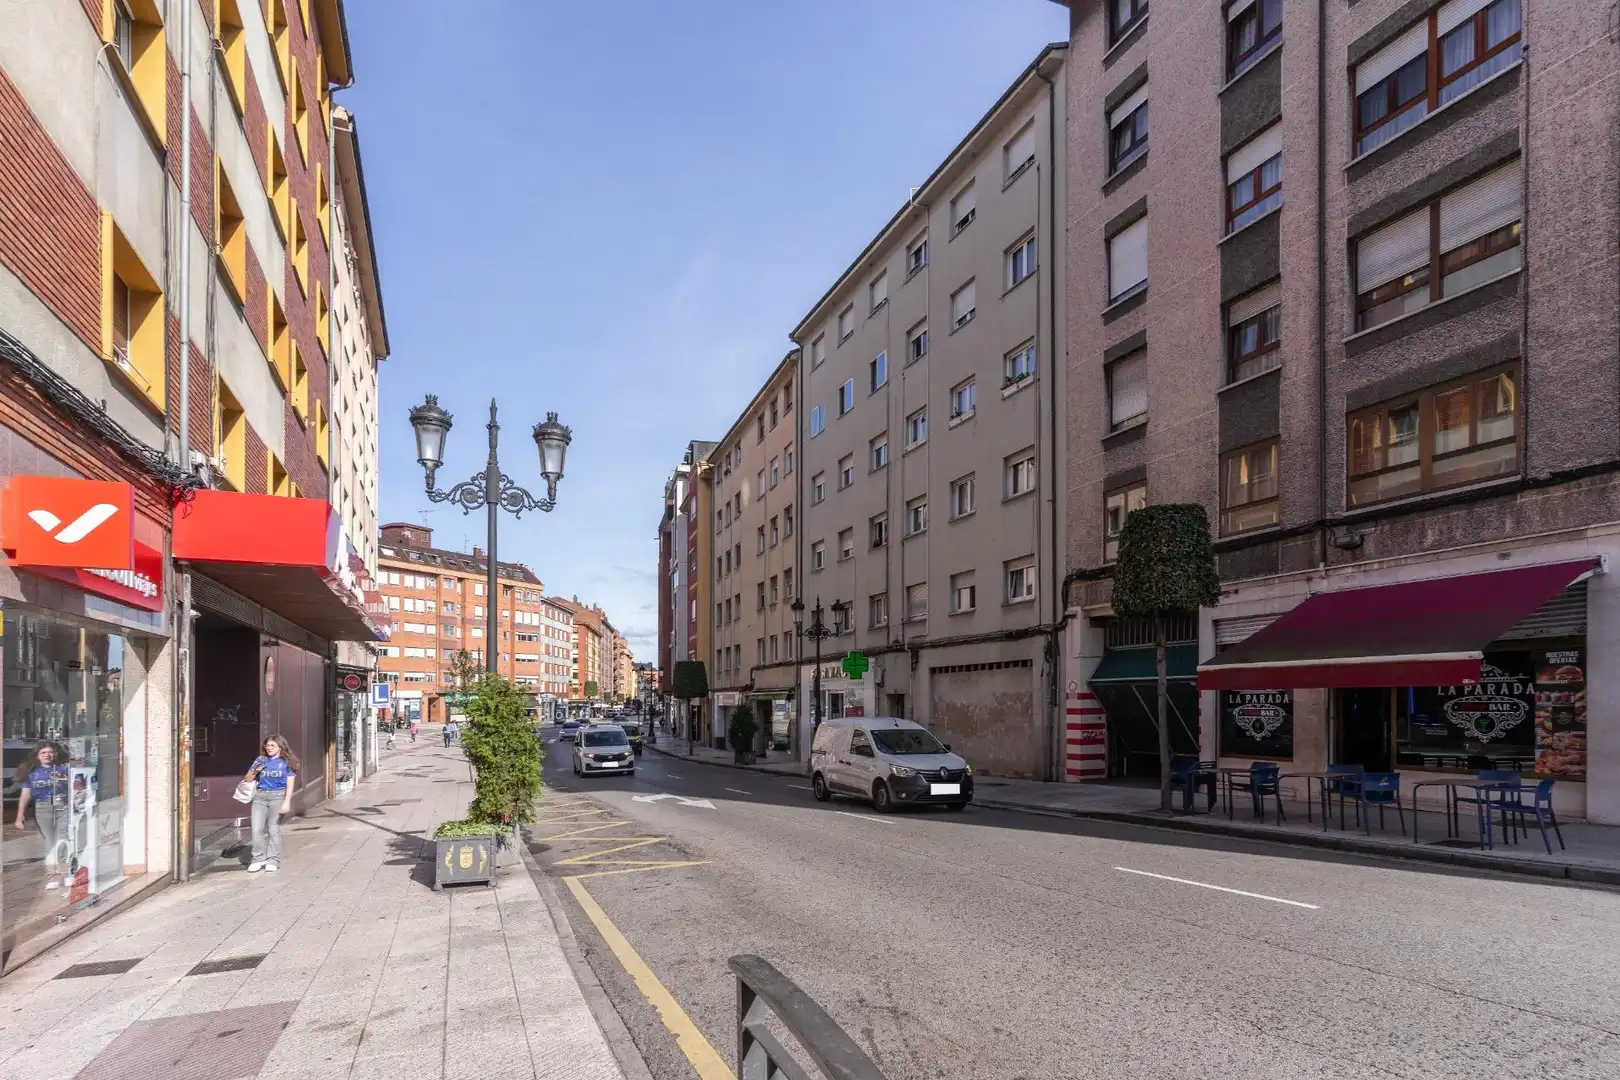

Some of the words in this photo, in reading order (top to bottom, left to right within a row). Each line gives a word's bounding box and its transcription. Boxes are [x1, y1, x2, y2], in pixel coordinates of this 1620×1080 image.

[375, 685, 387, 702] L
[1438, 686, 1456, 696] LA
[1464, 683, 1535, 696] PARADA
[1229, 694, 1242, 704] LA
[1246, 694, 1289, 704] PARADA
[1489, 703, 1511, 711] BAR
